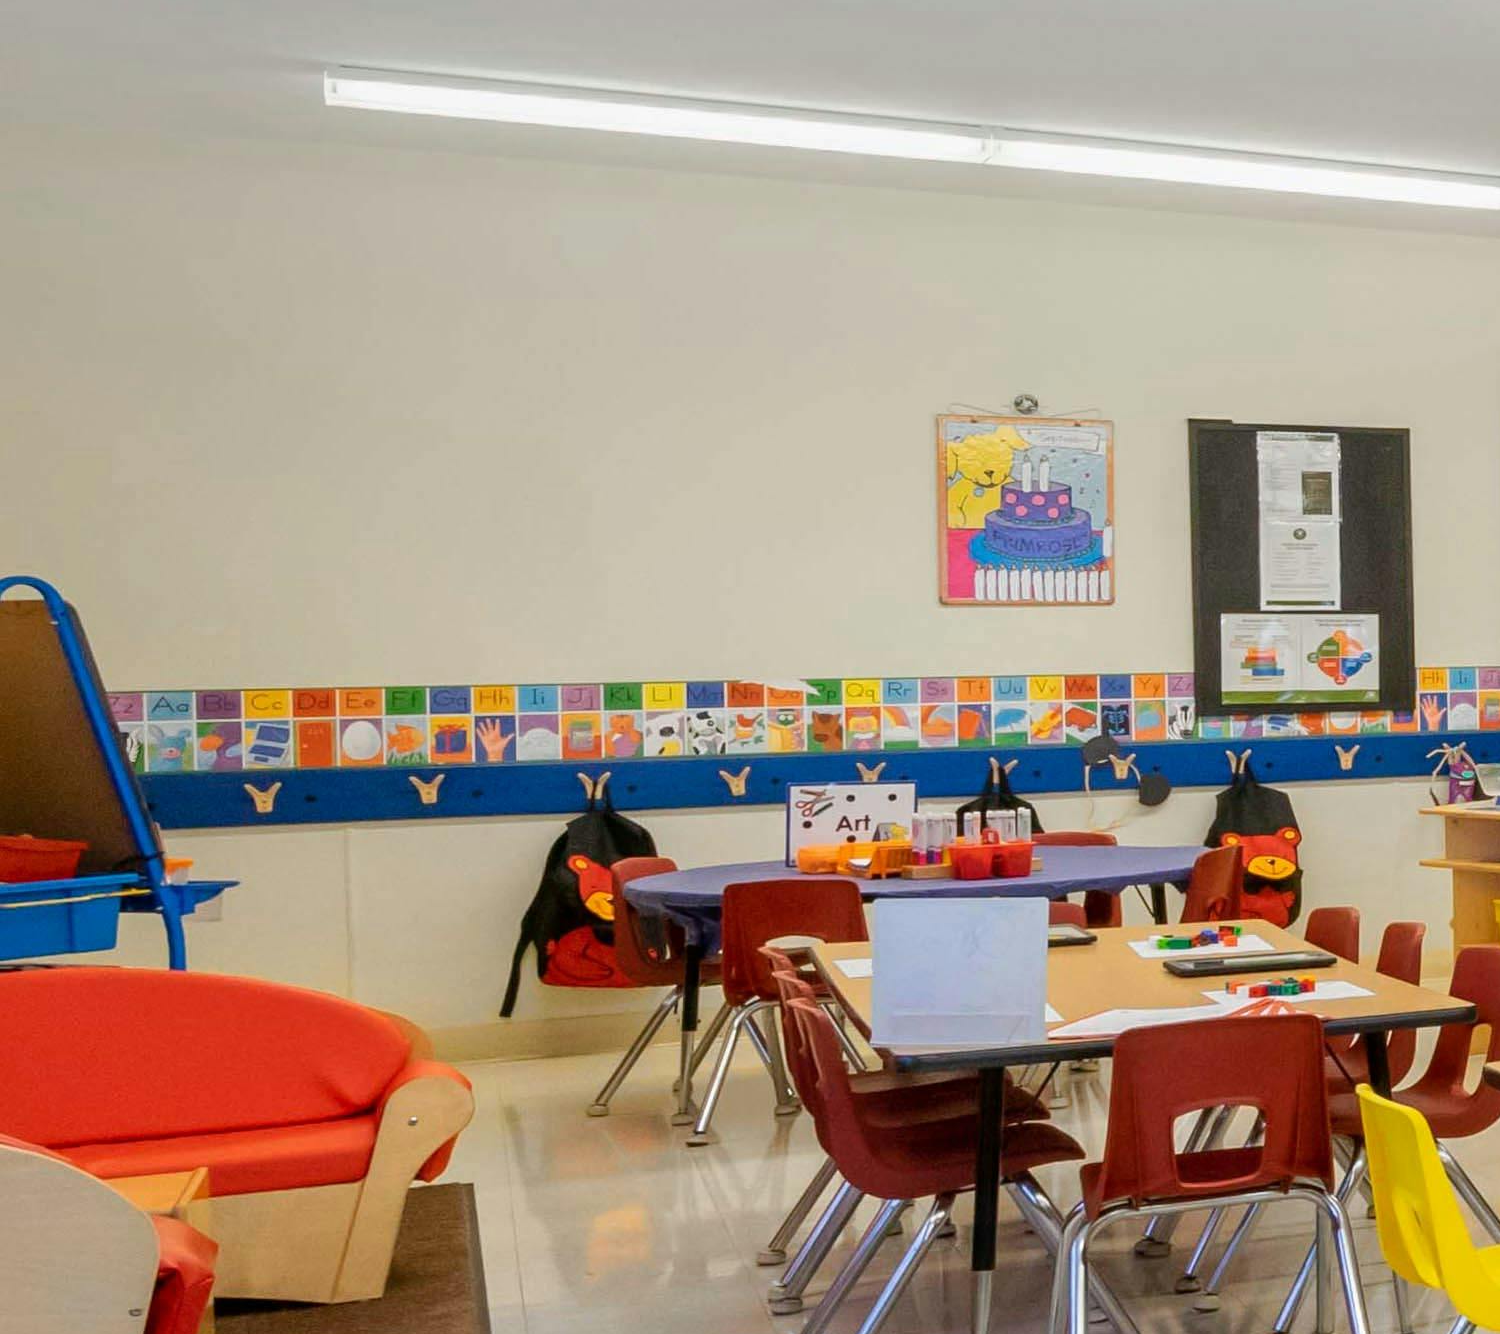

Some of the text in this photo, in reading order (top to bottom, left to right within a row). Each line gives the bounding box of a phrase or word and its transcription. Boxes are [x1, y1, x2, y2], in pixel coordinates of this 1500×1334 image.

[151, 695, 189, 713] Aa
[250, 693, 282, 711] Cc
[296, 693, 329, 710] Dd
[345, 691, 376, 710] Ee
[478, 689, 511, 707] Hh
[530, 688, 546, 706] Ii
[845, 682, 881, 704] Qq
[887, 681, 914, 697] Rr
[965, 679, 986, 696] Tt
[997, 680, 1024, 695] Uu
[1034, 679, 1057, 694] Vv
[1137, 677, 1161, 697] Yy
[835, 814, 872, 833] Art
